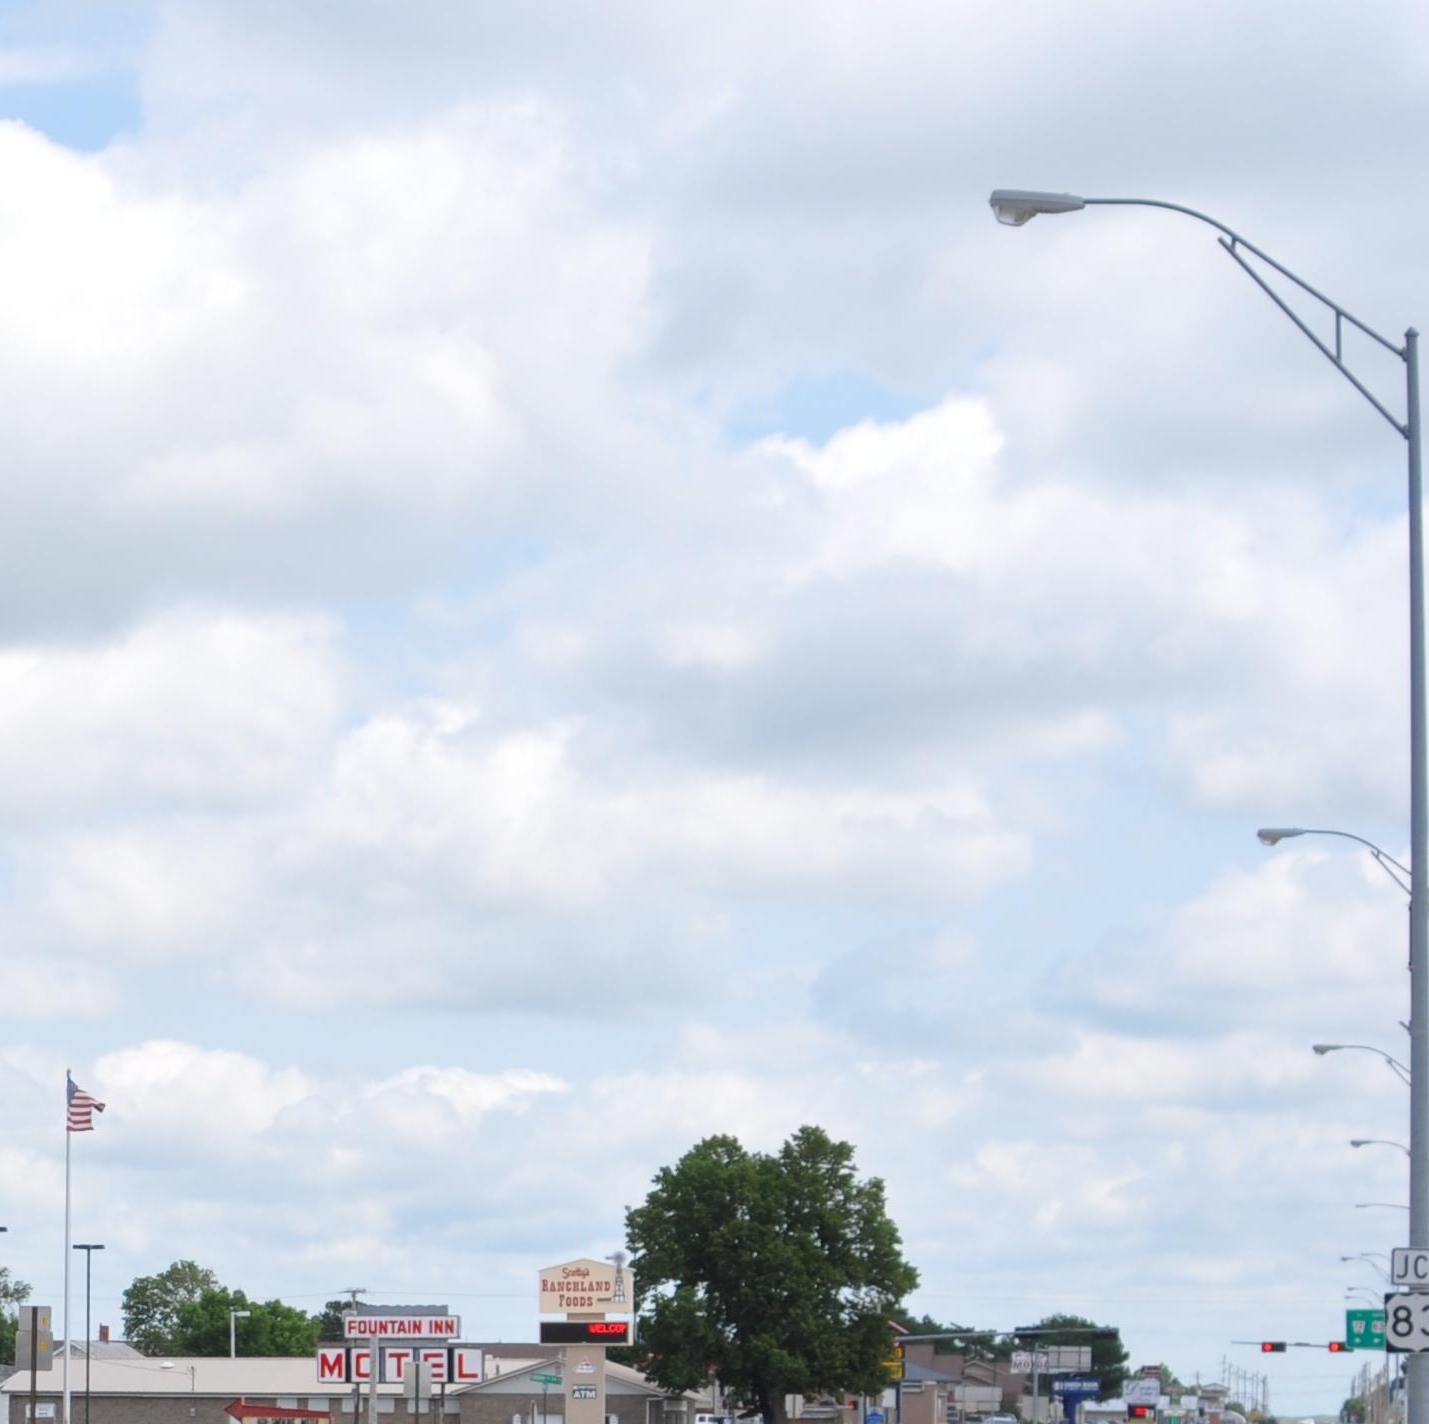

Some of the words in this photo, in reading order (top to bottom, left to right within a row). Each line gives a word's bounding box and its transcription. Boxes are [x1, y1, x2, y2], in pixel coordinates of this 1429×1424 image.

[542, 1279, 611, 1292] RANCHLAND
[559, 1294, 593, 1307] FOODS
[347, 1320, 422, 1334] FOUNTAIN
[429, 1319, 455, 1334] INN
[320, 1353, 478, 1378] MOTEL
[574, 1390, 596, 1399] ATM
